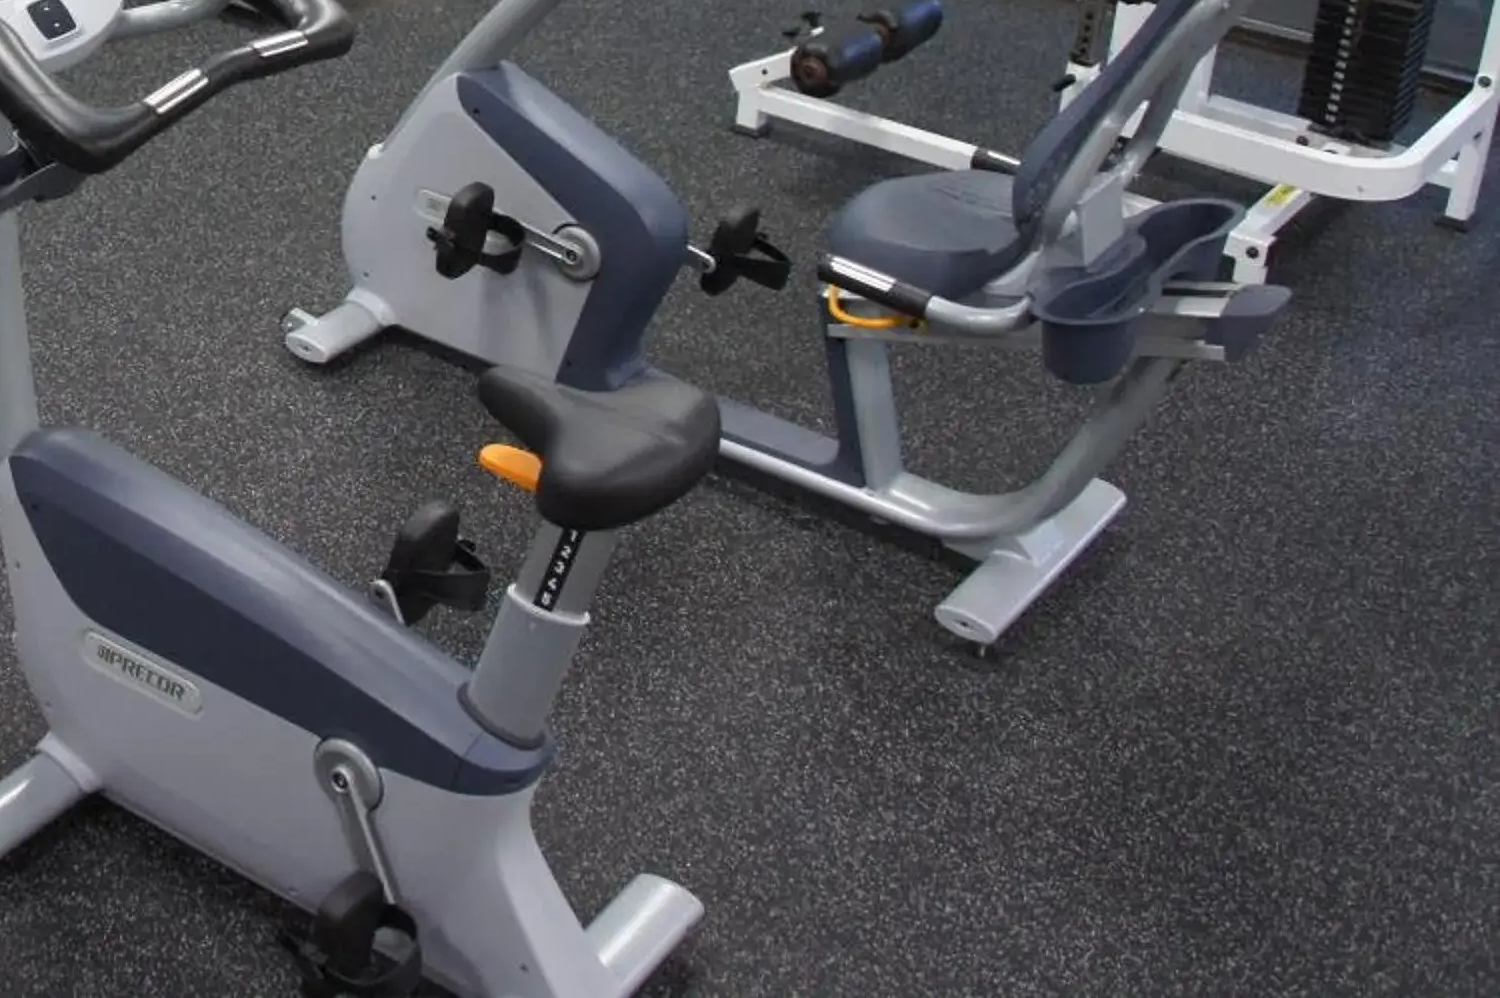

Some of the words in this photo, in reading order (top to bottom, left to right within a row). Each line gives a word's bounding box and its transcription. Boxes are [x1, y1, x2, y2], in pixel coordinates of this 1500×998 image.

[570, 529, 579, 542] 1
[561, 545, 572, 559] 2
[554, 561, 565, 575] 3
[108, 649, 187, 701] PRECOR
